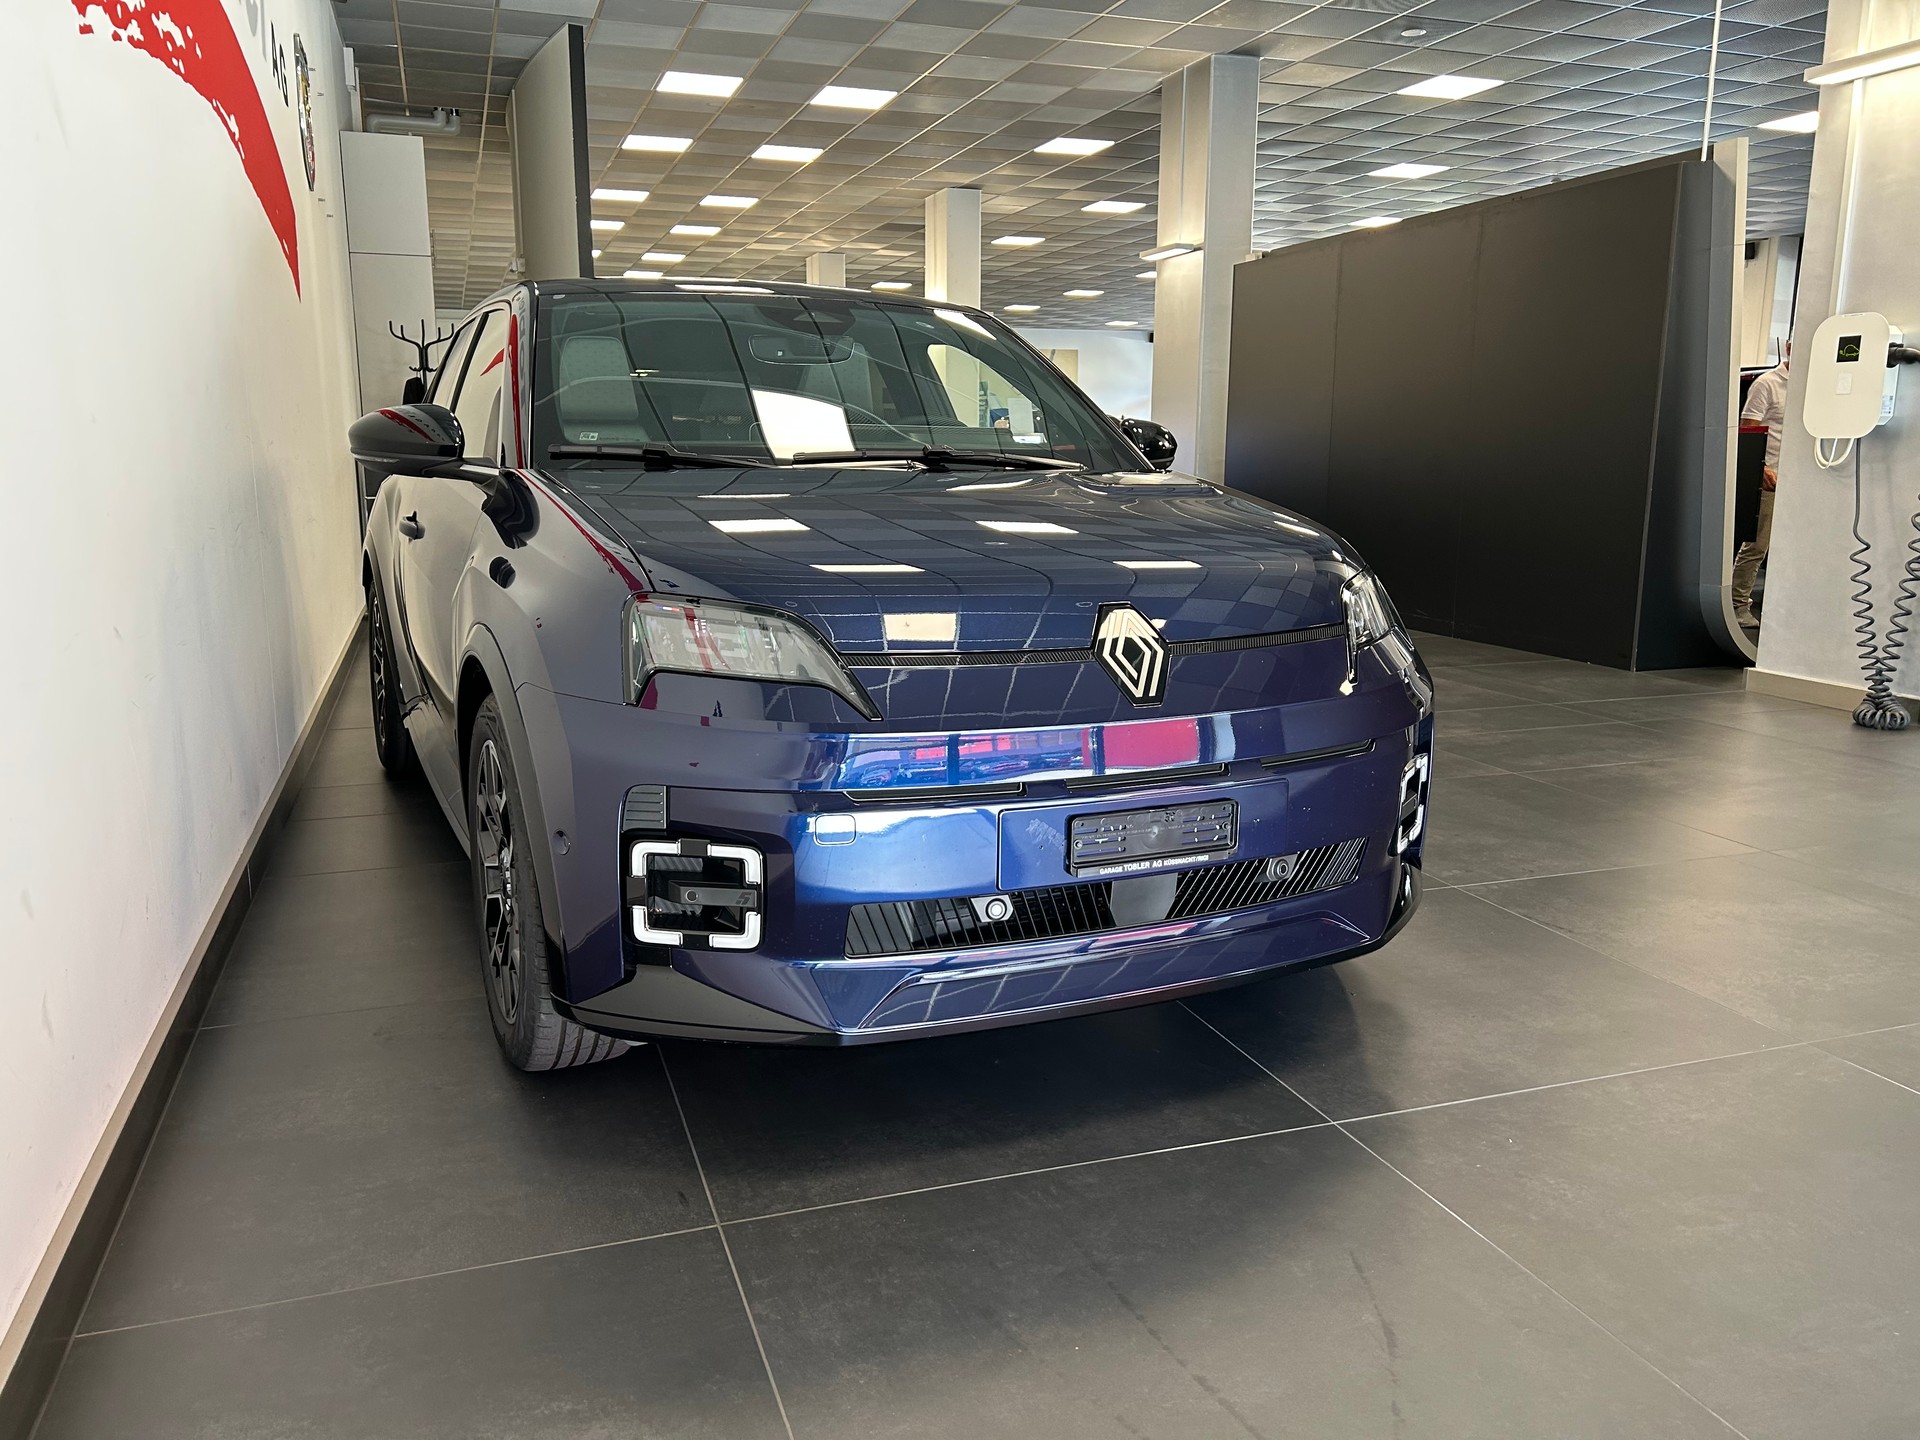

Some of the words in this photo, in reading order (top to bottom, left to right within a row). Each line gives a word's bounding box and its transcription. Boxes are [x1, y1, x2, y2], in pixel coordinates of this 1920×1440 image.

[271, 20, 289, 107] AG
[1124, 861, 1150, 871] TOBLER
[1152, 860, 1163, 868] AG
